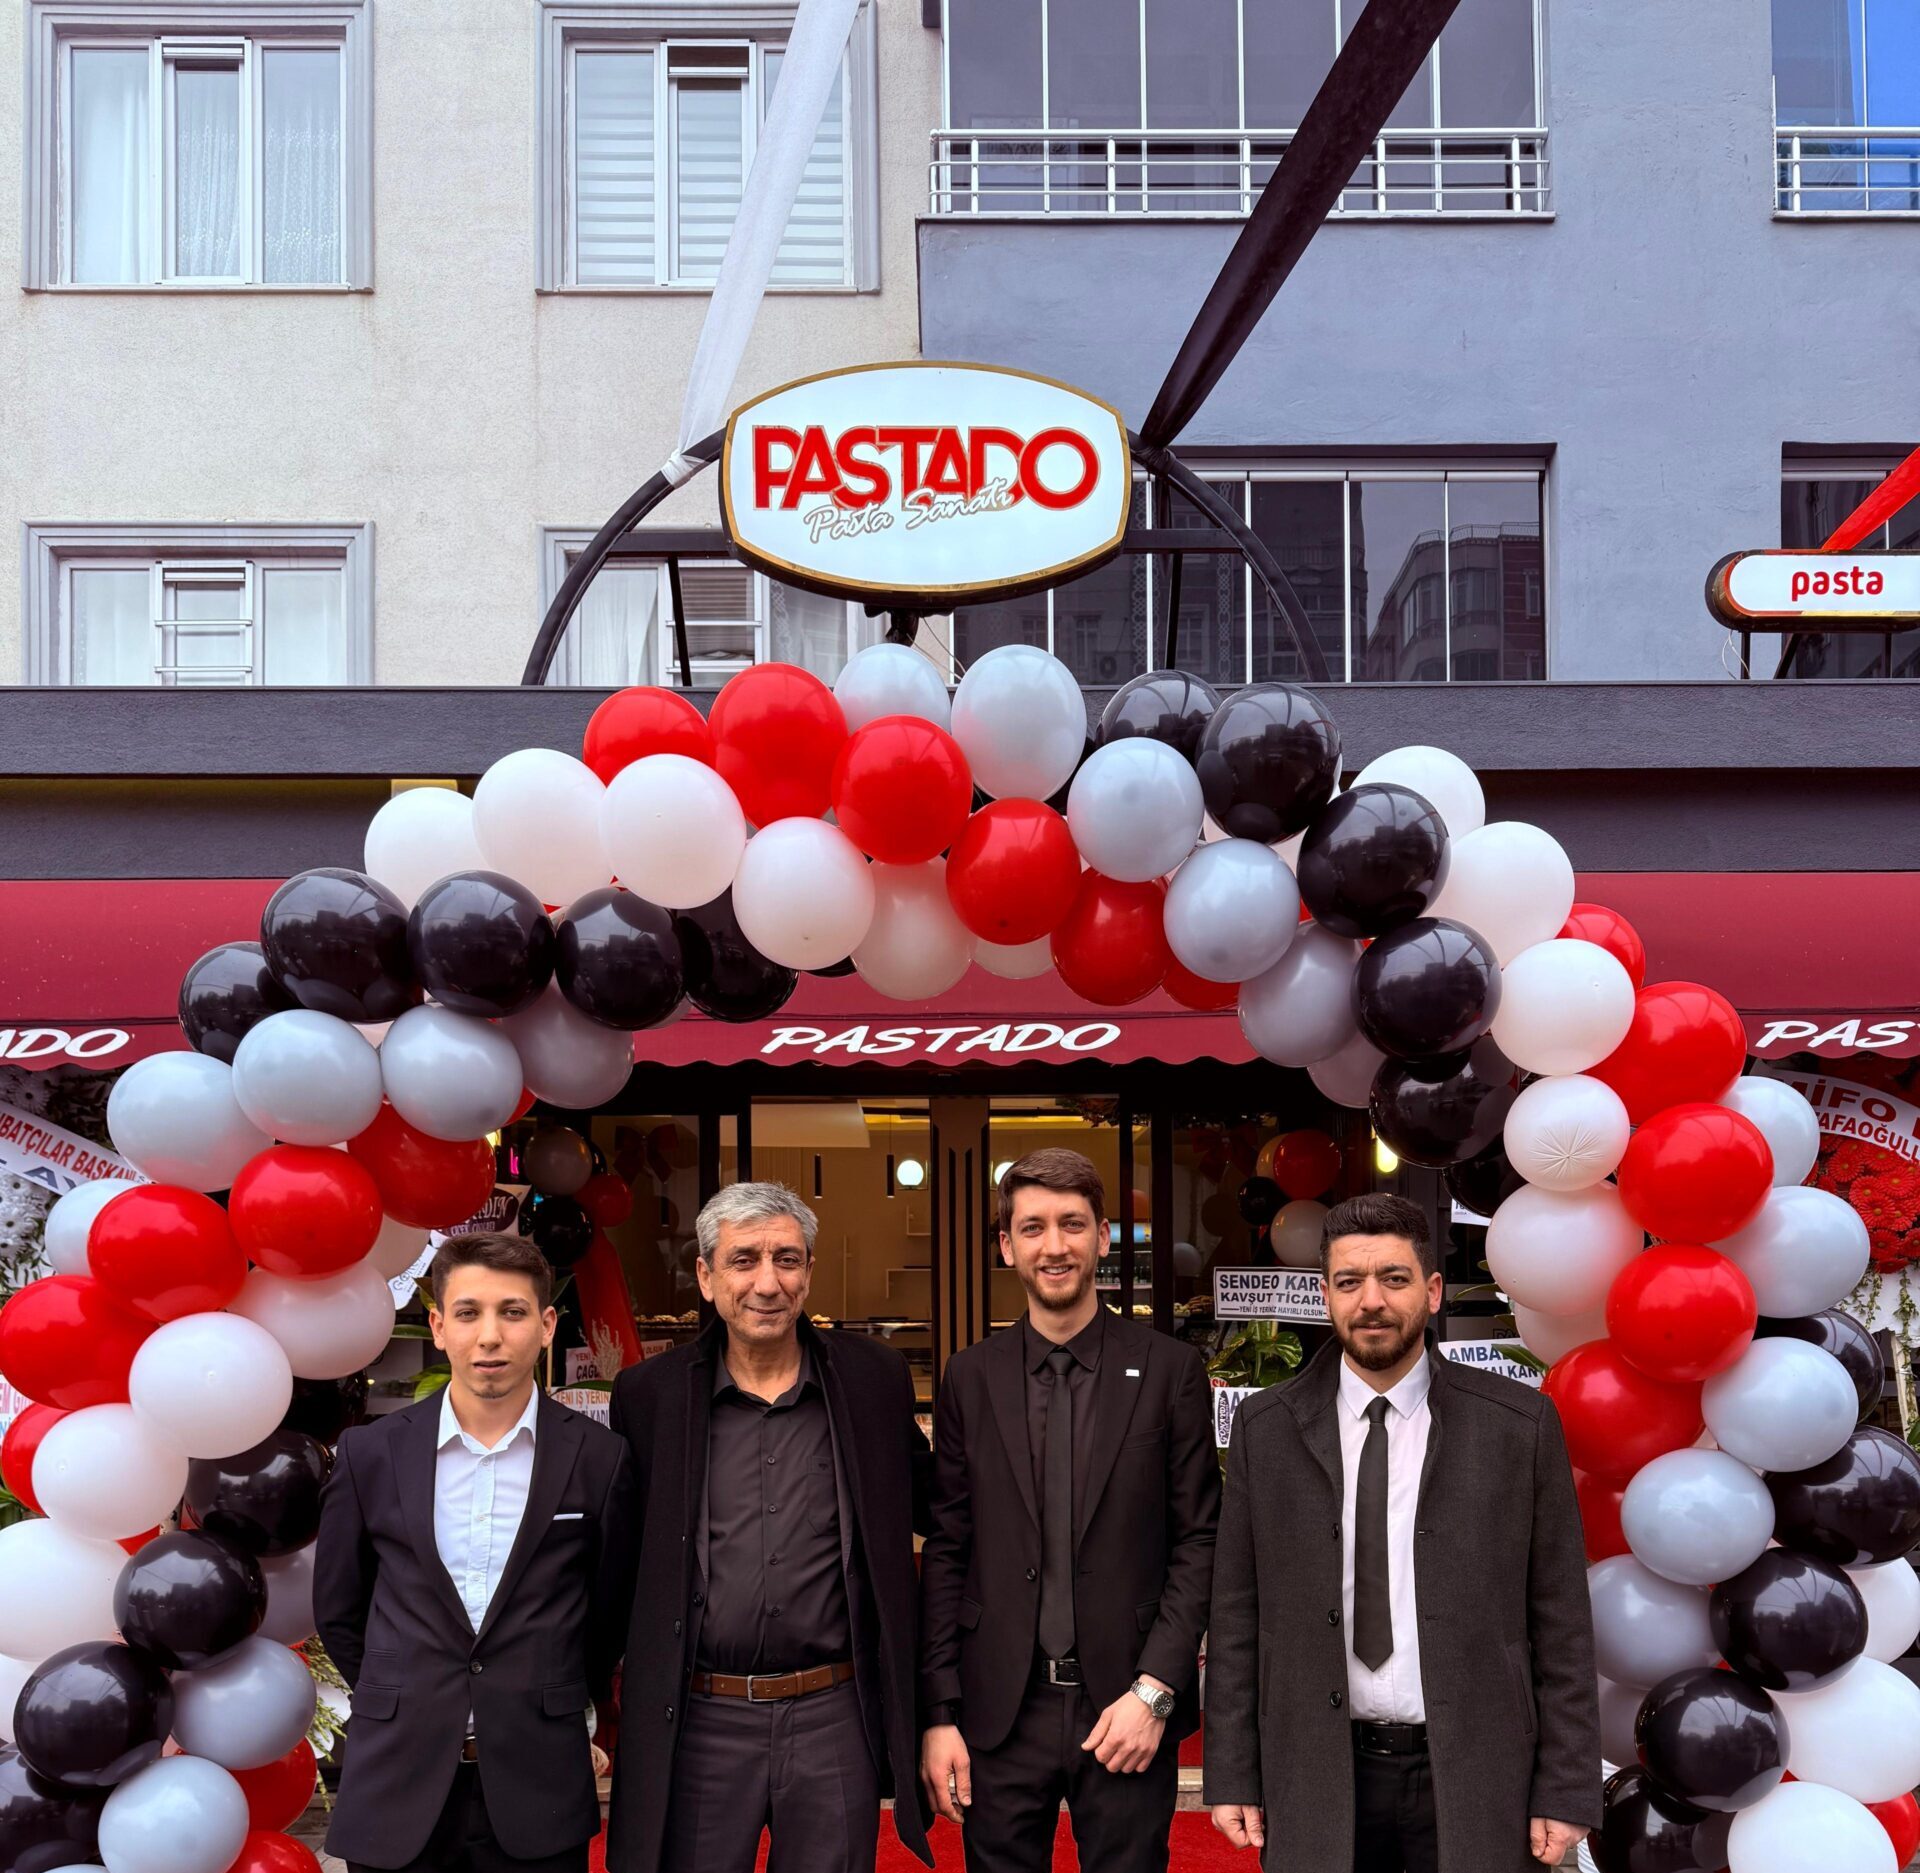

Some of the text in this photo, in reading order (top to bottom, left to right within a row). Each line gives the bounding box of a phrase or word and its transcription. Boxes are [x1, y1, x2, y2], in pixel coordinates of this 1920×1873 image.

[752, 424, 1101, 511] PASTADO
[803, 501, 894, 544] Pasta
[1791, 566, 1884, 602] pasta
[760, 1023, 1121, 1054] PASTADO
[1755, 1019, 1920, 1048] PAS
[1221, 1292, 1273, 1305] KAVŞUT
[1284, 1275, 1323, 1292] KAR
[1303, 1308, 1323, 1317] OLSUN
